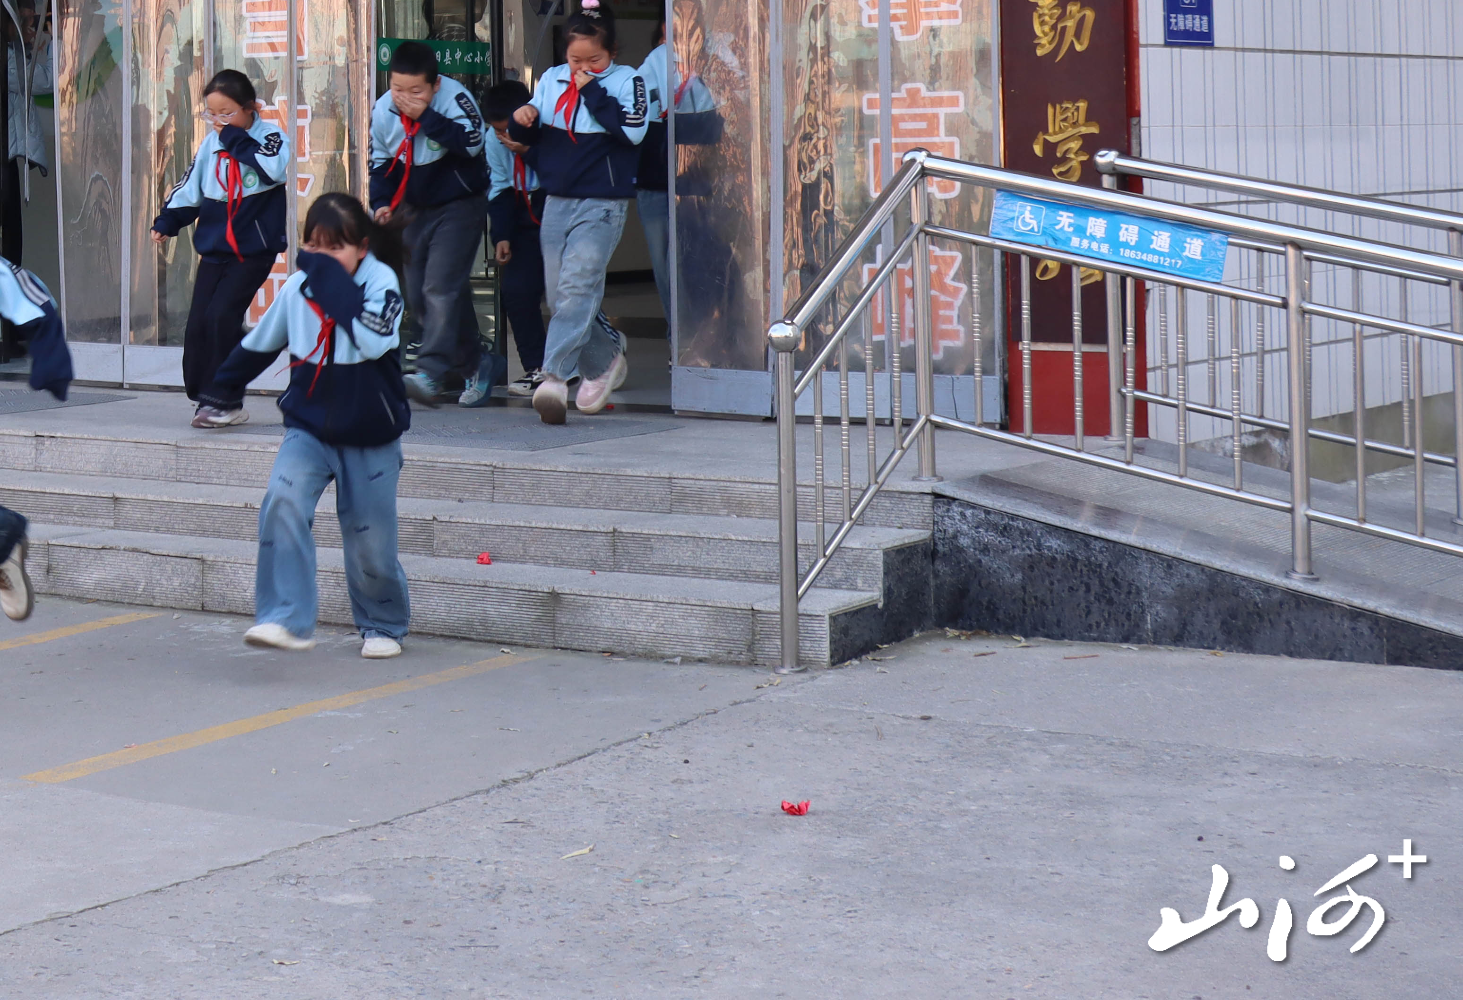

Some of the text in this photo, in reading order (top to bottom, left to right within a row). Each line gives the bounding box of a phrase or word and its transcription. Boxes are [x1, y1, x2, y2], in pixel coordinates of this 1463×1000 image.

[1170, 13, 1209, 33] 无障碍通道
[1054, 210, 1205, 260] 无障碍通道
